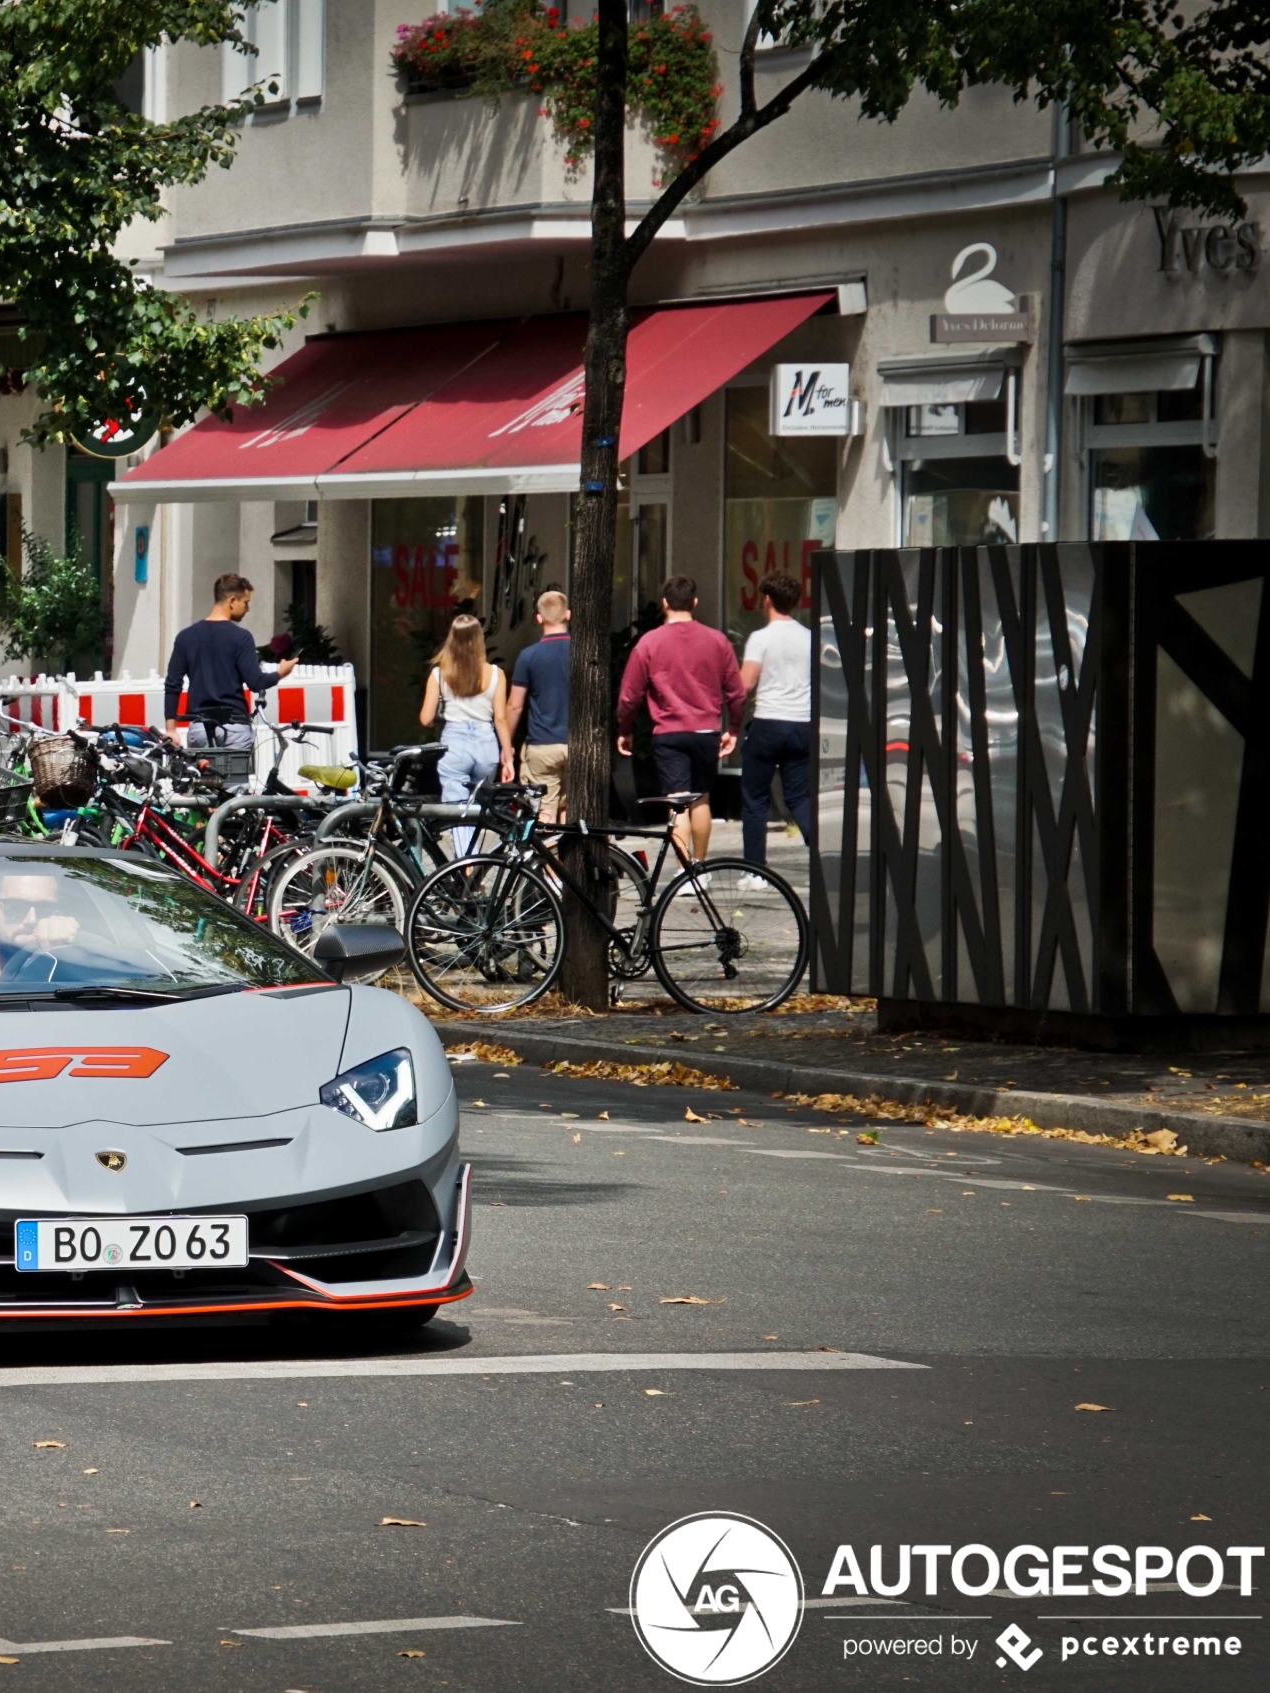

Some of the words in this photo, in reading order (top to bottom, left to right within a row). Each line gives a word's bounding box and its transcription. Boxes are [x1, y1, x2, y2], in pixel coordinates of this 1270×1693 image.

[1150, 204, 1263, 272] Yves
[816, 384, 835, 400] for
[823, 397, 847, 409] men
[394, 543, 460, 608] SALE
[23, 1250, 33, 1262] D
[54, 1226, 102, 1263] BO
[129, 1225, 177, 1261] ZO
[185, 1223, 230, 1260] 63
